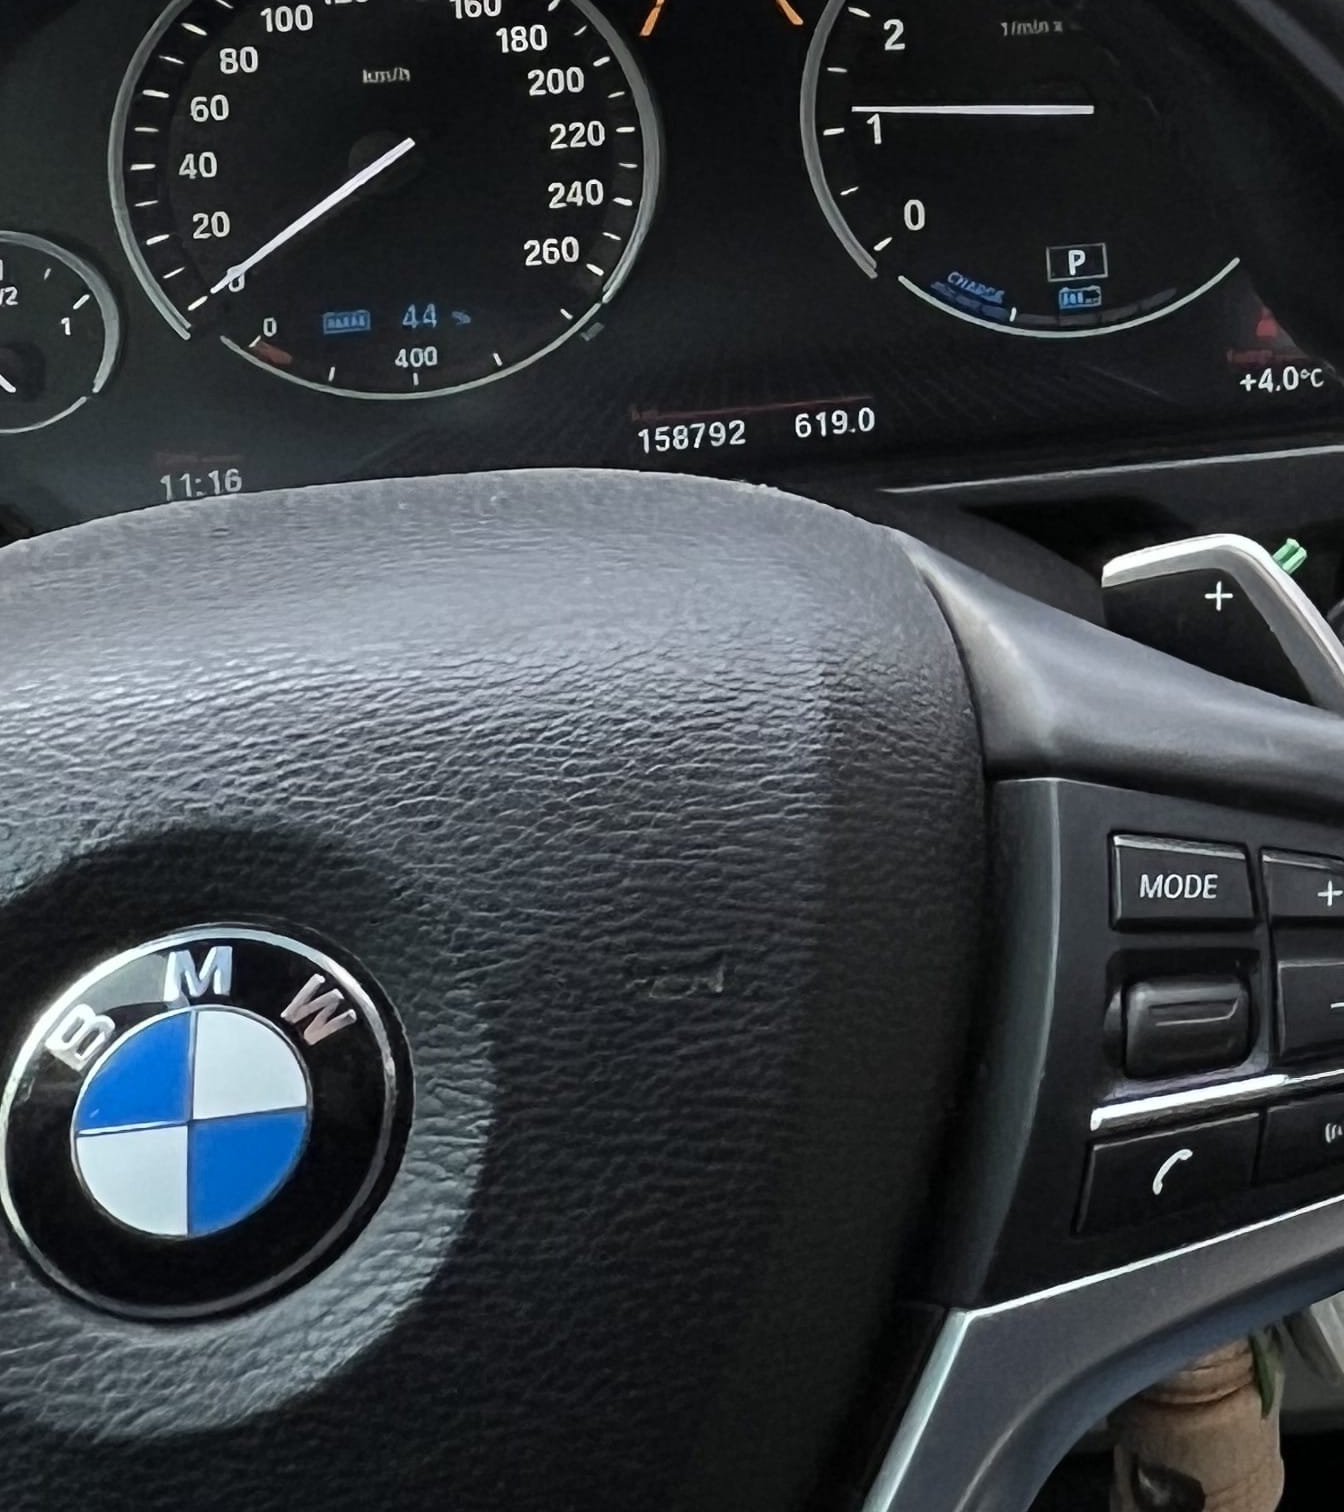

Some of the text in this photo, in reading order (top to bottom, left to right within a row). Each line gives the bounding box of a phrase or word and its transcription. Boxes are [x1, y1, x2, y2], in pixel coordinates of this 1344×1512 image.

[260, 4, 314, 33] 100
[495, 24, 548, 54] 180
[883, 18, 906, 51] 2
[219, 46, 259, 75] 80
[362, 67, 411, 84] km/h
[527, 66, 585, 97] 200
[190, 94, 230, 123] 60
[549, 120, 606, 150] 220
[866, 113, 882, 145] 1
[178, 151, 218, 180] 40
[547, 178, 604, 209] 240
[192, 211, 231, 240] 20
[903, 199, 926, 231] 0
[523, 236, 580, 267] 260
[1067, 249, 1087, 276] P
[61, 316, 71, 336] 1
[262, 316, 278, 338] 0
[402, 303, 438, 329] 44
[394, 345, 438, 368] 400
[637, 407, 875, 454] 158792 619.0
[160, 468, 242, 501] 11:16
[1139, 873, 1219, 899] MODE
[45, 945, 357, 1072] BMW
